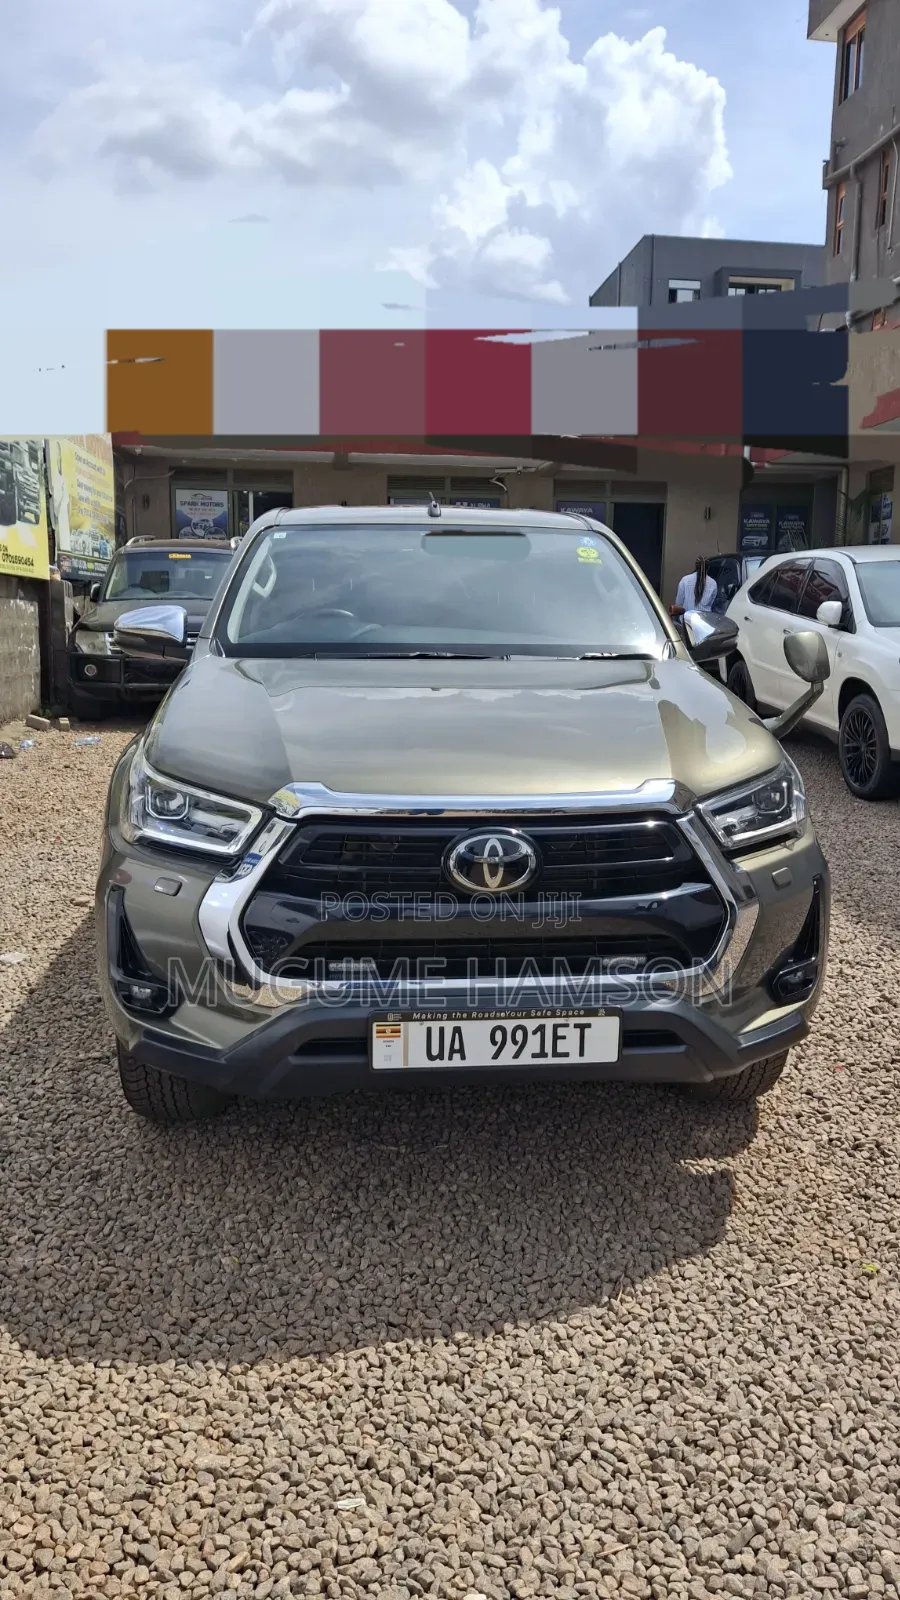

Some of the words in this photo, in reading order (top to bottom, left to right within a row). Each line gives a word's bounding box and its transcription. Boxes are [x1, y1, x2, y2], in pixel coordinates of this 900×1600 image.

[412, 1012, 448, 1021] Making
[451, 1011, 468, 1019] the
[530, 1008, 552, 1017] Safe
[555, 1008, 585, 1017] Space
[425, 1025, 466, 1062] UA
[489, 1022, 592, 1060] 991ET
